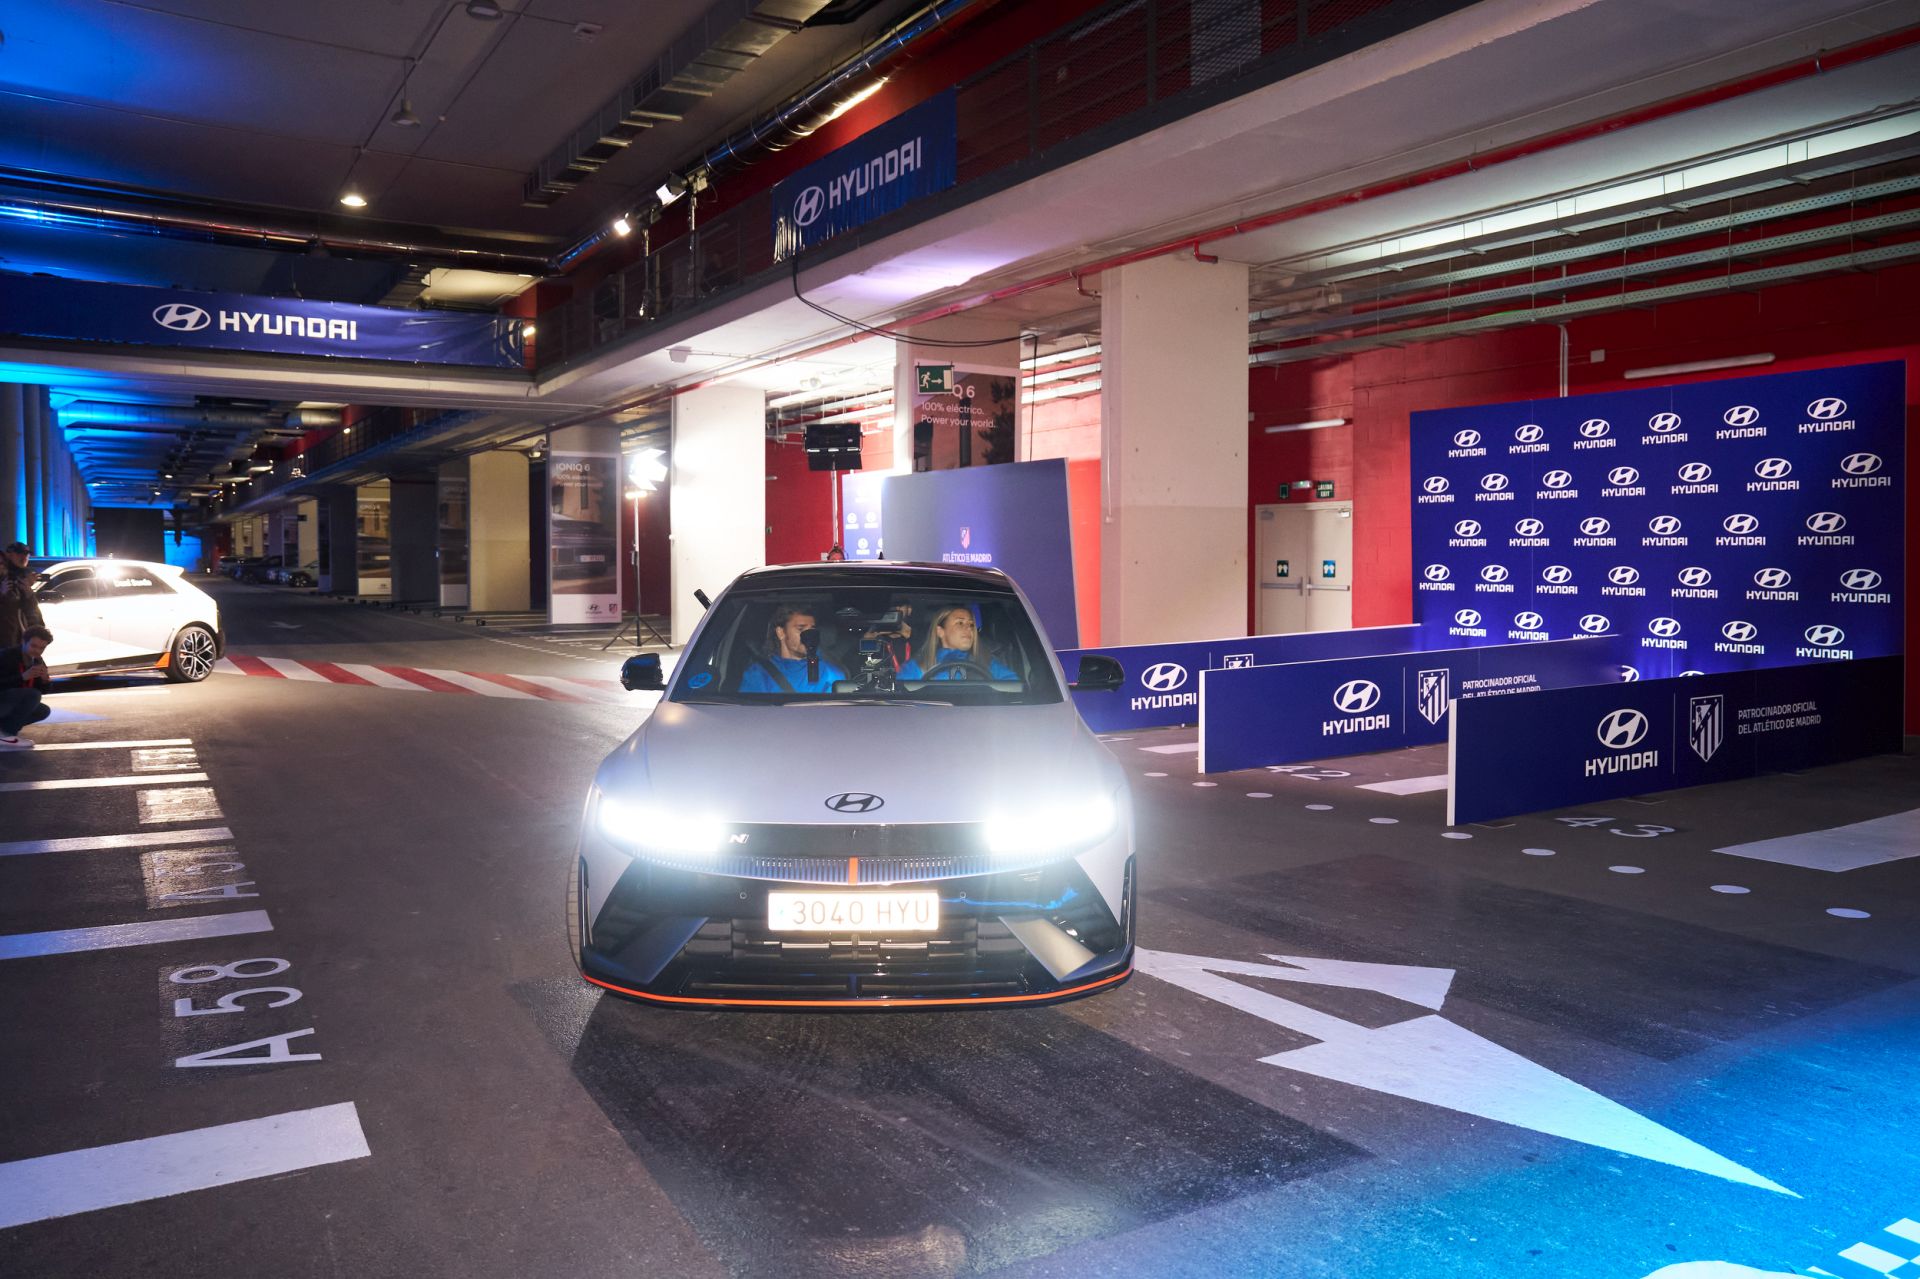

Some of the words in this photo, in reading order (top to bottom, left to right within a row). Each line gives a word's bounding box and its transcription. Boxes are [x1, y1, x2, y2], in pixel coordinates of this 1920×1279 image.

[829, 137, 922, 210] HYUNDAI
[219, 310, 357, 341] HYUNDAI
[966, 385, 976, 398] 6
[922, 402, 944, 412] 100%
[921, 415, 948, 424] Power
[950, 418, 969, 426] your
[1799, 420, 1855, 433] HYUNDAI
[1642, 433, 1687, 445] HYUNDAI
[1716, 427, 1766, 440] HYUNDAI
[1509, 444, 1549, 454] HYUNDAI
[1574, 439, 1616, 450] HYUNDAI
[1449, 448, 1486, 457] HYUNDAI
[1747, 481, 1799, 492] HYUNDAI
[1832, 477, 1890, 488] HYUNDAI
[1537, 490, 1578, 500] HYUNDAI
[1602, 487, 1645, 498] HYUNDAI
[1672, 484, 1718, 495] HYUNDAI
[1418, 495, 1454, 503] HYUNDAI
[1475, 492, 1514, 501] HYUNDAI
[1449, 539, 1486, 547] HYUNDAI
[1509, 538, 1549, 547] HYUNDAI
[1574, 538, 1616, 547] HYUNDAI
[1642, 537, 1687, 547] HYUNDAI
[1716, 537, 1765, 546] HYUNDAI
[1798, 536, 1854, 546] HYUNDAI
[971, 553, 992, 562] MADRID
[1420, 583, 1455, 591] HYUNDAI
[1475, 584, 1514, 593] HYUNDAI
[1536, 585, 1578, 595] HYUNDAI
[1602, 587, 1645, 597] HYUNDAI
[1672, 589, 1718, 599] HYUNDAI
[1746, 591, 1798, 601] HYUNDAI
[1832, 593, 1890, 604] HYUNDAI
[1449, 627, 1486, 637] HYUNDAI
[1508, 630, 1549, 641] HYUNDAI
[1642, 638, 1687, 650] HYUNDAI
[1715, 643, 1764, 655] HYUNDAI
[1796, 648, 1853, 660] HYUNDAI
[1463, 677, 1512, 690] PATROCINADOR
[1513, 674, 1537, 685] OFICIAL
[1131, 692, 1197, 711] HYUNDAI
[1738, 704, 1791, 720] PATROCINADOR
[1792, 701, 1818, 713] OFICIAL
[1322, 713, 1390, 736] HYUNDAI
[1738, 724, 1751, 735] DEL
[1753, 719, 1785, 733] ATLÉTICO
[1785, 718, 1795, 728] DE
[1796, 714, 1822, 726] MADRID
[1585, 750, 1658, 777] HYUNDAI
[1554, 817, 1676, 838] 43
[792, 900, 864, 925] 3040
[877, 900, 929, 925] HYU
